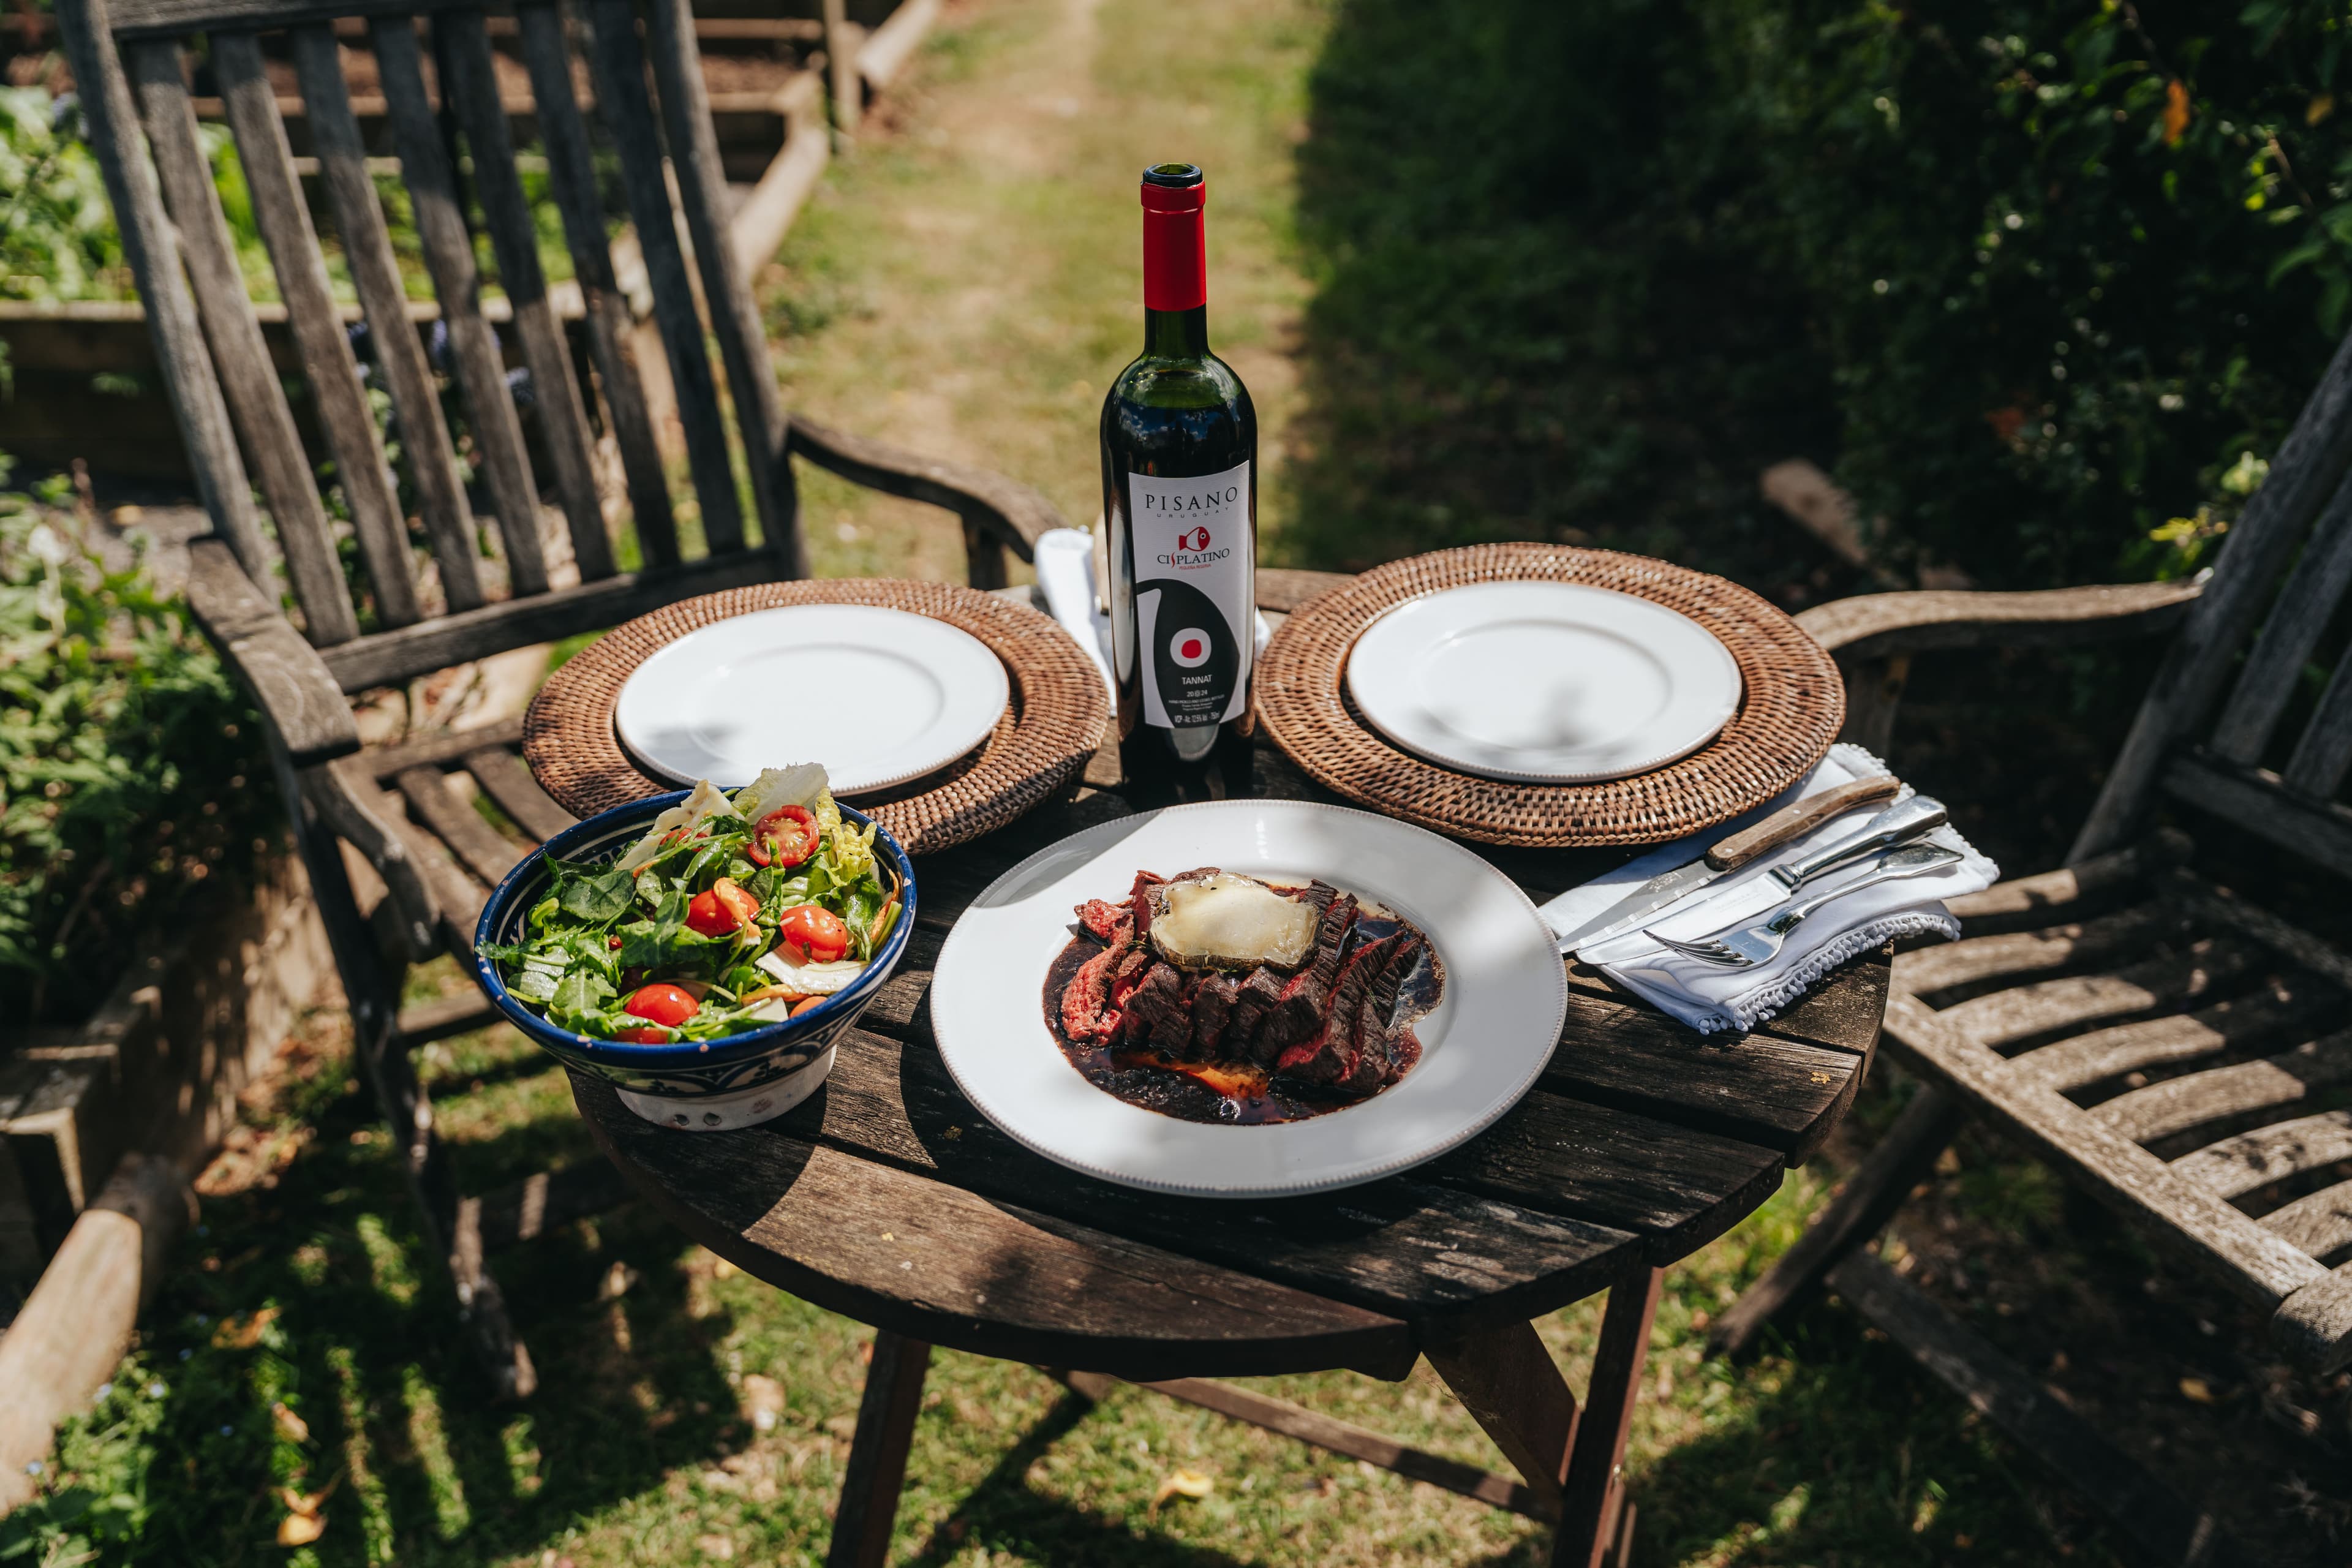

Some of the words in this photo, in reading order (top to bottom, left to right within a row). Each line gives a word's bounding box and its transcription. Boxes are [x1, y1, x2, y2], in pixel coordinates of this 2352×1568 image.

[1145, 487, 1238, 511] PISANO
[1156, 507, 1229, 518] URUGUAY
[1157, 548, 1230, 569] CISPLATINO
[1182, 674, 1212, 685] TANNAT
